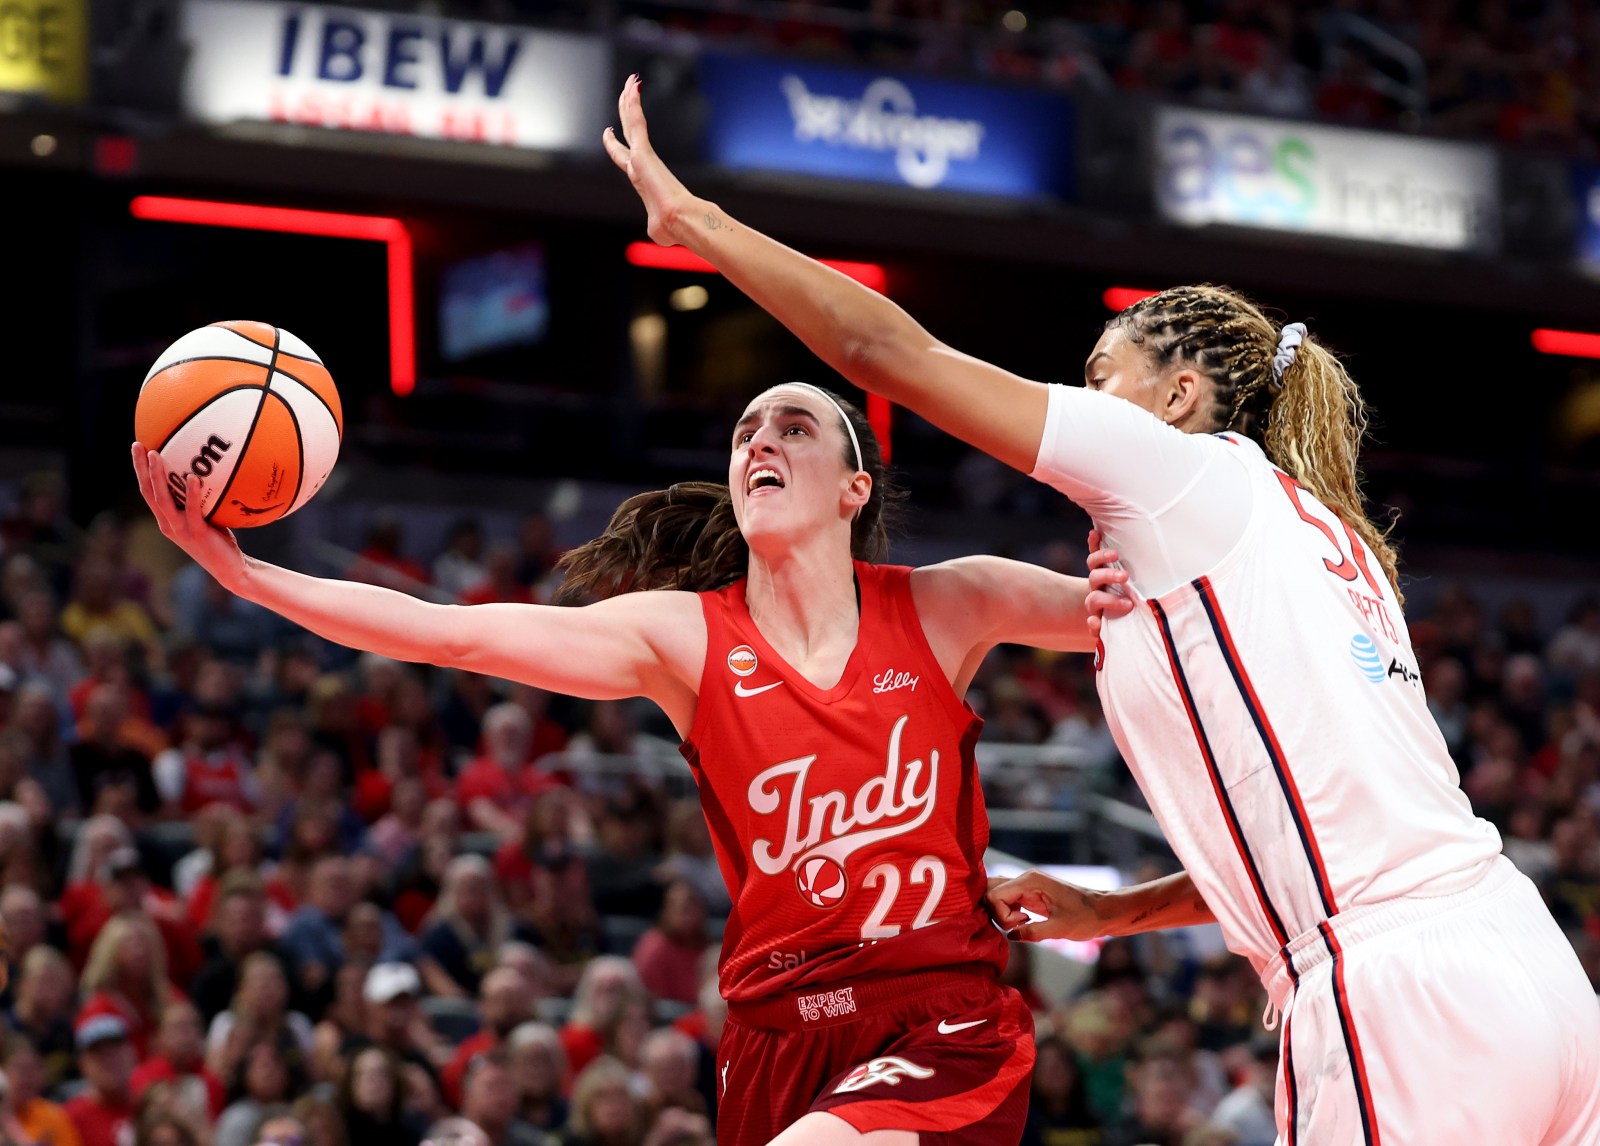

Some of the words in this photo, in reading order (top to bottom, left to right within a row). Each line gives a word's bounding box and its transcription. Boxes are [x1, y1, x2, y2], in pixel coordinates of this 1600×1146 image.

[277, 14, 522, 98] IBEW
[873, 668, 919, 693] Lilly
[748, 714, 939, 876] Indy
[860, 855, 947, 938] 22
[797, 987, 853, 1011] EXPECT
[800, 1009, 821, 1022] TO
[824, 1000, 857, 1018] WIN
